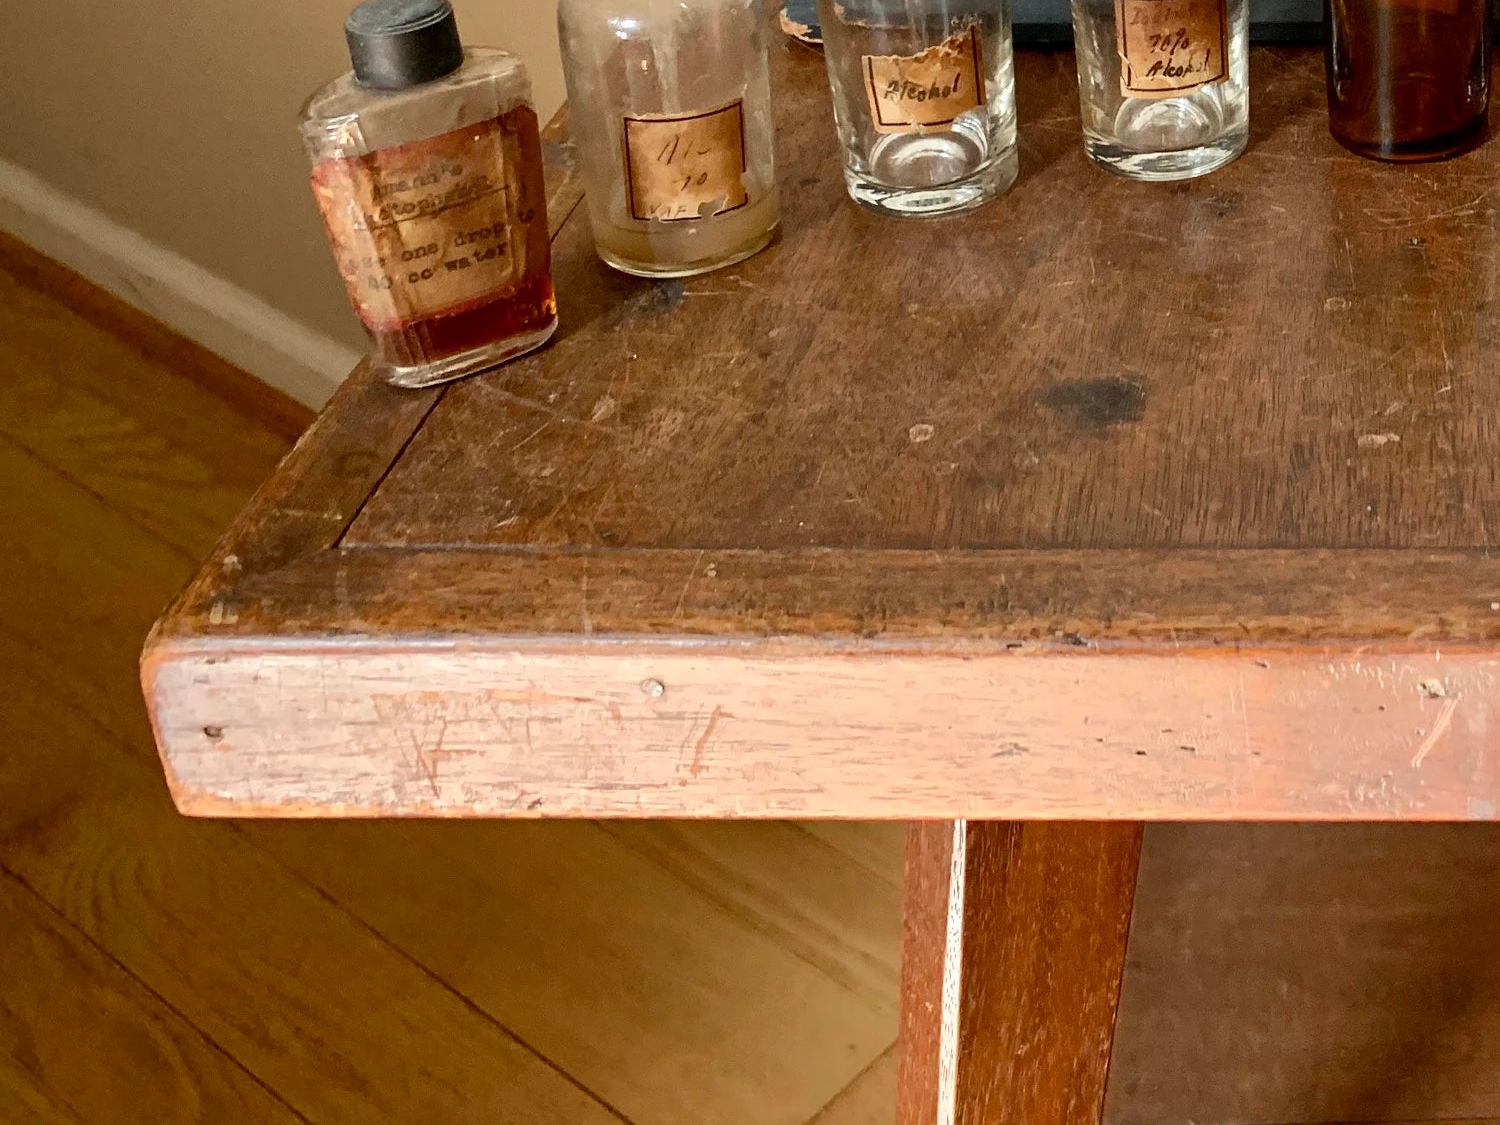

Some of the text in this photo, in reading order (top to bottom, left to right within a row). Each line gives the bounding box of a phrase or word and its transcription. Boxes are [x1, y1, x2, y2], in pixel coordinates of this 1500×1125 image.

[883, 72, 961, 102] Alcohol
[401, 243, 439, 262] one
[453, 224, 506, 249] drop
[407, 267, 435, 284] cc
[444, 242, 509, 272] water
